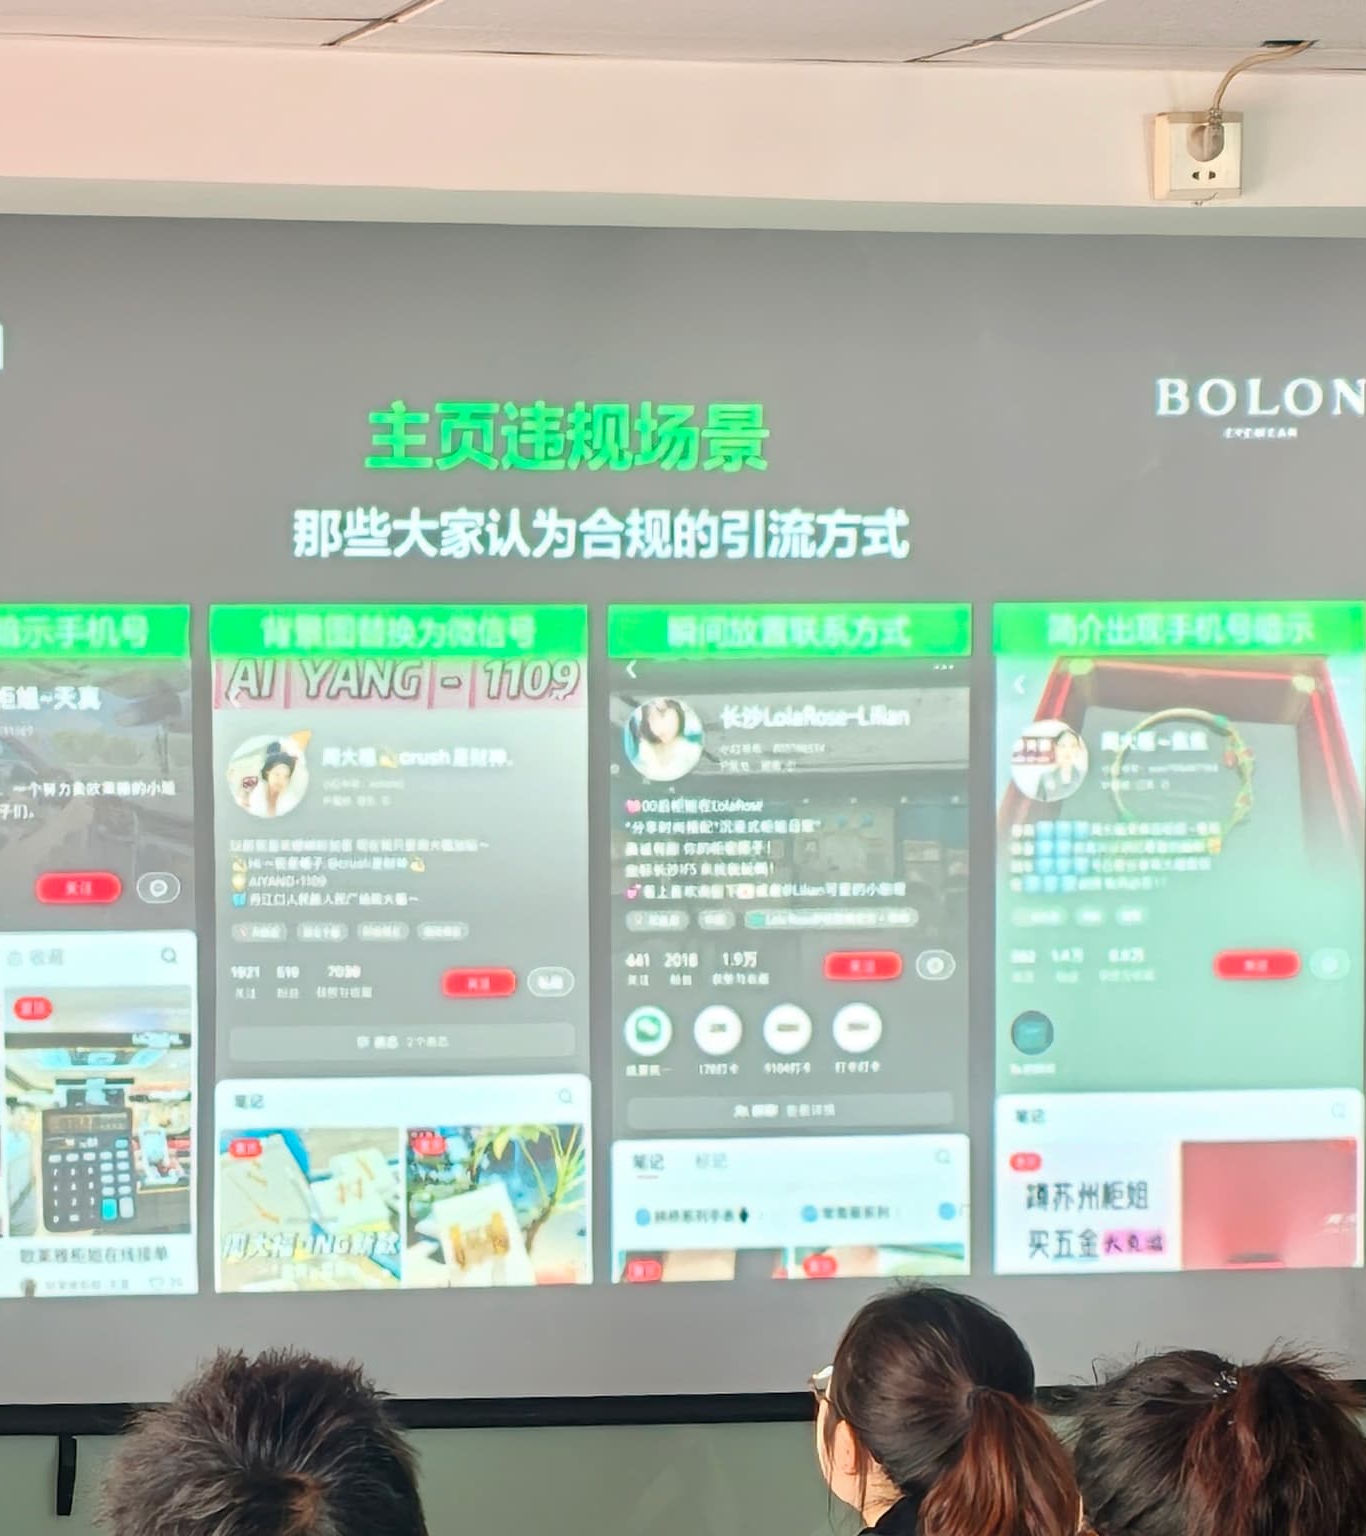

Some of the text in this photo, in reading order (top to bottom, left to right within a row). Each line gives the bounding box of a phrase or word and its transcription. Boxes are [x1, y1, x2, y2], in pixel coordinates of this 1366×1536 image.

[364, 398, 771, 473] 主页违规场景
[293, 506, 910, 561] 那些大家认为合规的引流方式
[226, 658, 275, 700] AI
[300, 658, 425, 700] YANG
[483, 659, 581, 701] 1109
